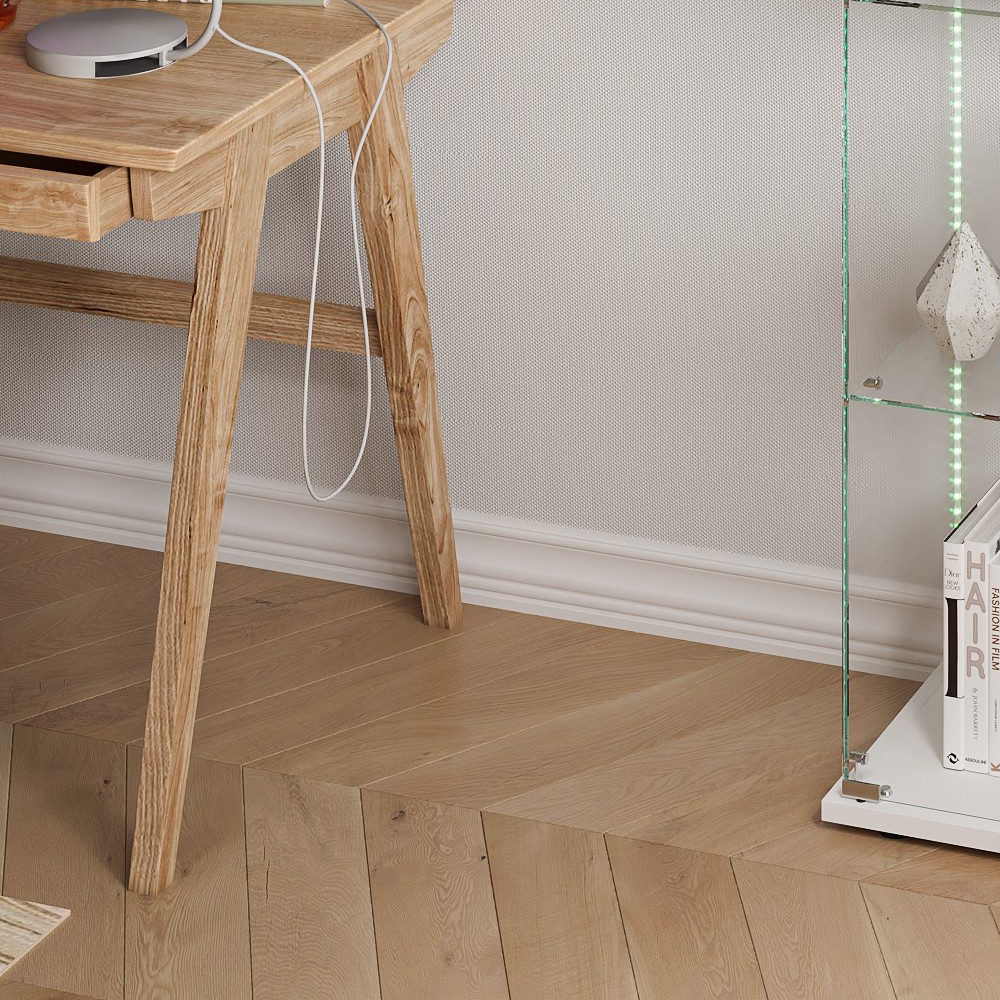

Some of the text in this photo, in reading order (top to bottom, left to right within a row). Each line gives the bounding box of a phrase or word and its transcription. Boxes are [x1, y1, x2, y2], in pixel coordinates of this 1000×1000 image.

[944, 568, 961, 578] Dior
[965, 550, 986, 680] HAIR
[991, 587, 1000, 671] FASHION IN FILM
